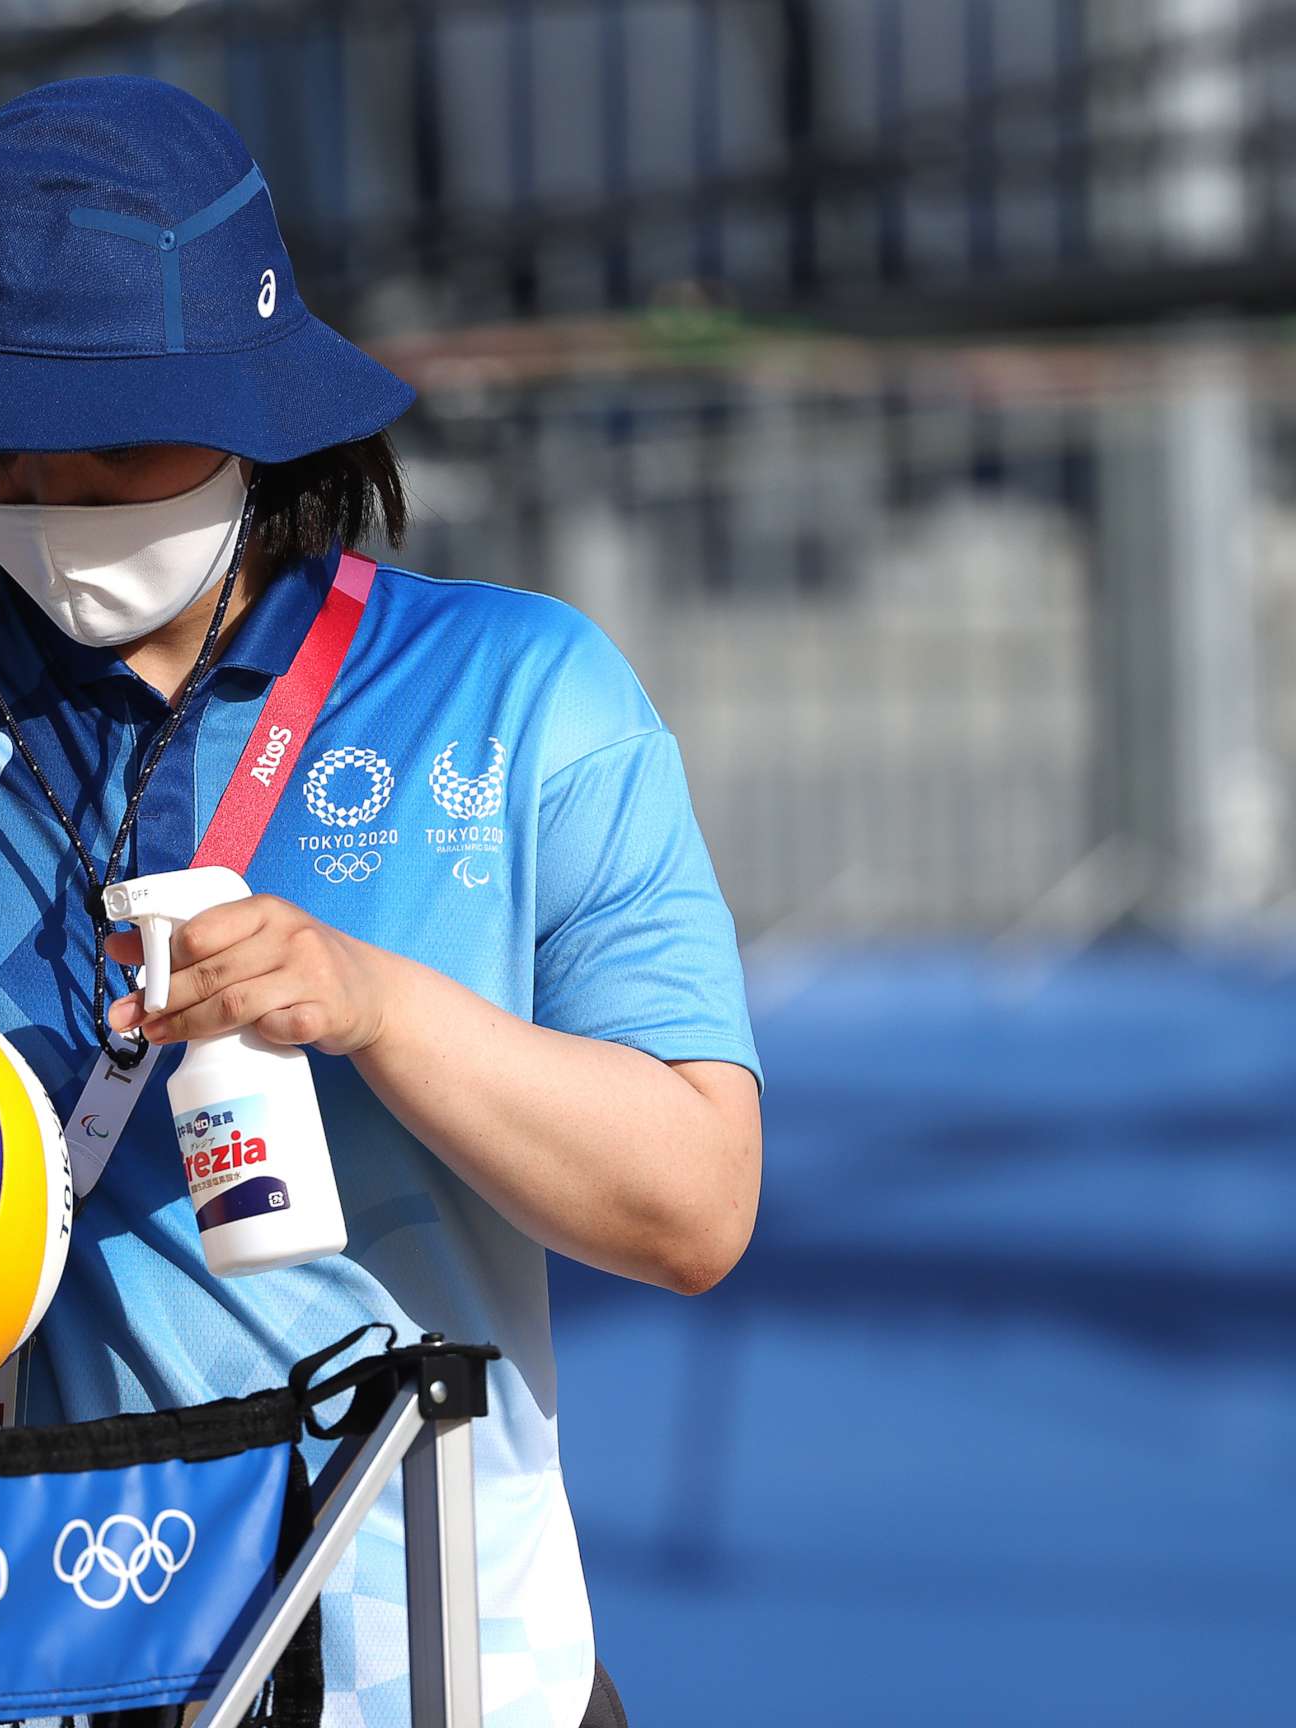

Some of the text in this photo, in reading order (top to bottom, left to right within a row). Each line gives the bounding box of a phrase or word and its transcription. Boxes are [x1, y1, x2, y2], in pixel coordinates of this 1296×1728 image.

[250, 725, 292, 788] Atos
[298, 829, 399, 850] TOKYO 2020
[425, 826, 479, 845] TOKYO
[182, 1129, 267, 1182] rezia
